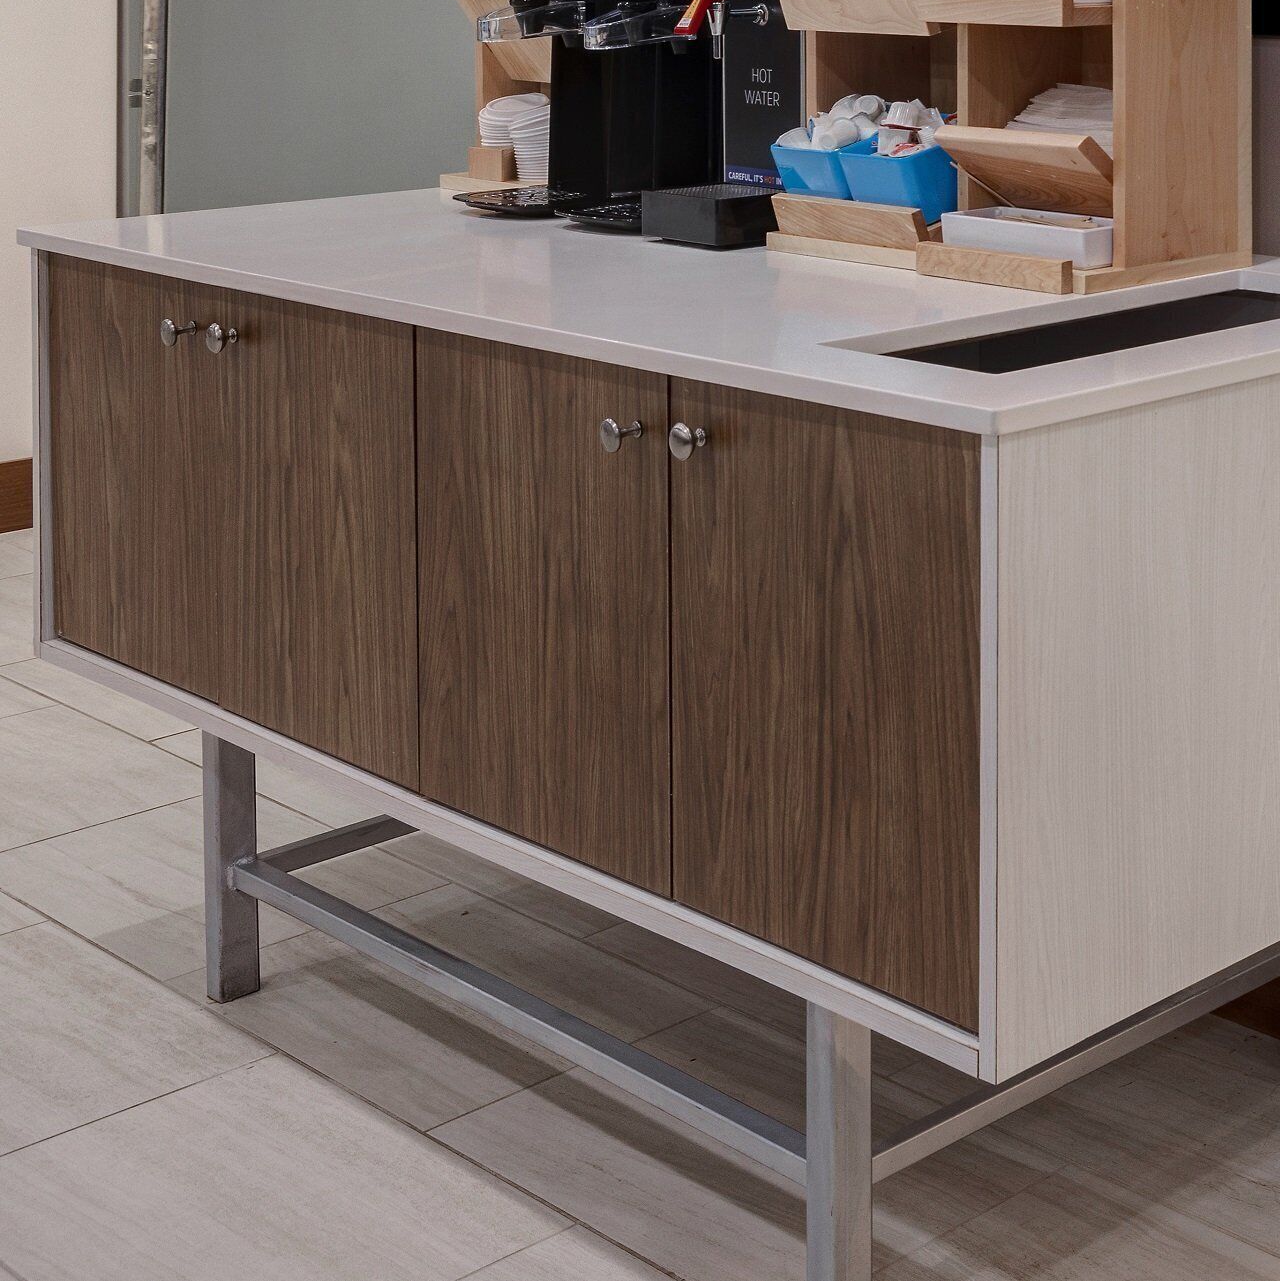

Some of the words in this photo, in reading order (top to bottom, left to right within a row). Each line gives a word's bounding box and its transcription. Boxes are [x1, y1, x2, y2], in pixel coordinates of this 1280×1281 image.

[751, 68, 773, 83] HOT
[744, 89, 780, 107] WATER
[753, 174, 764, 183] IT'S
